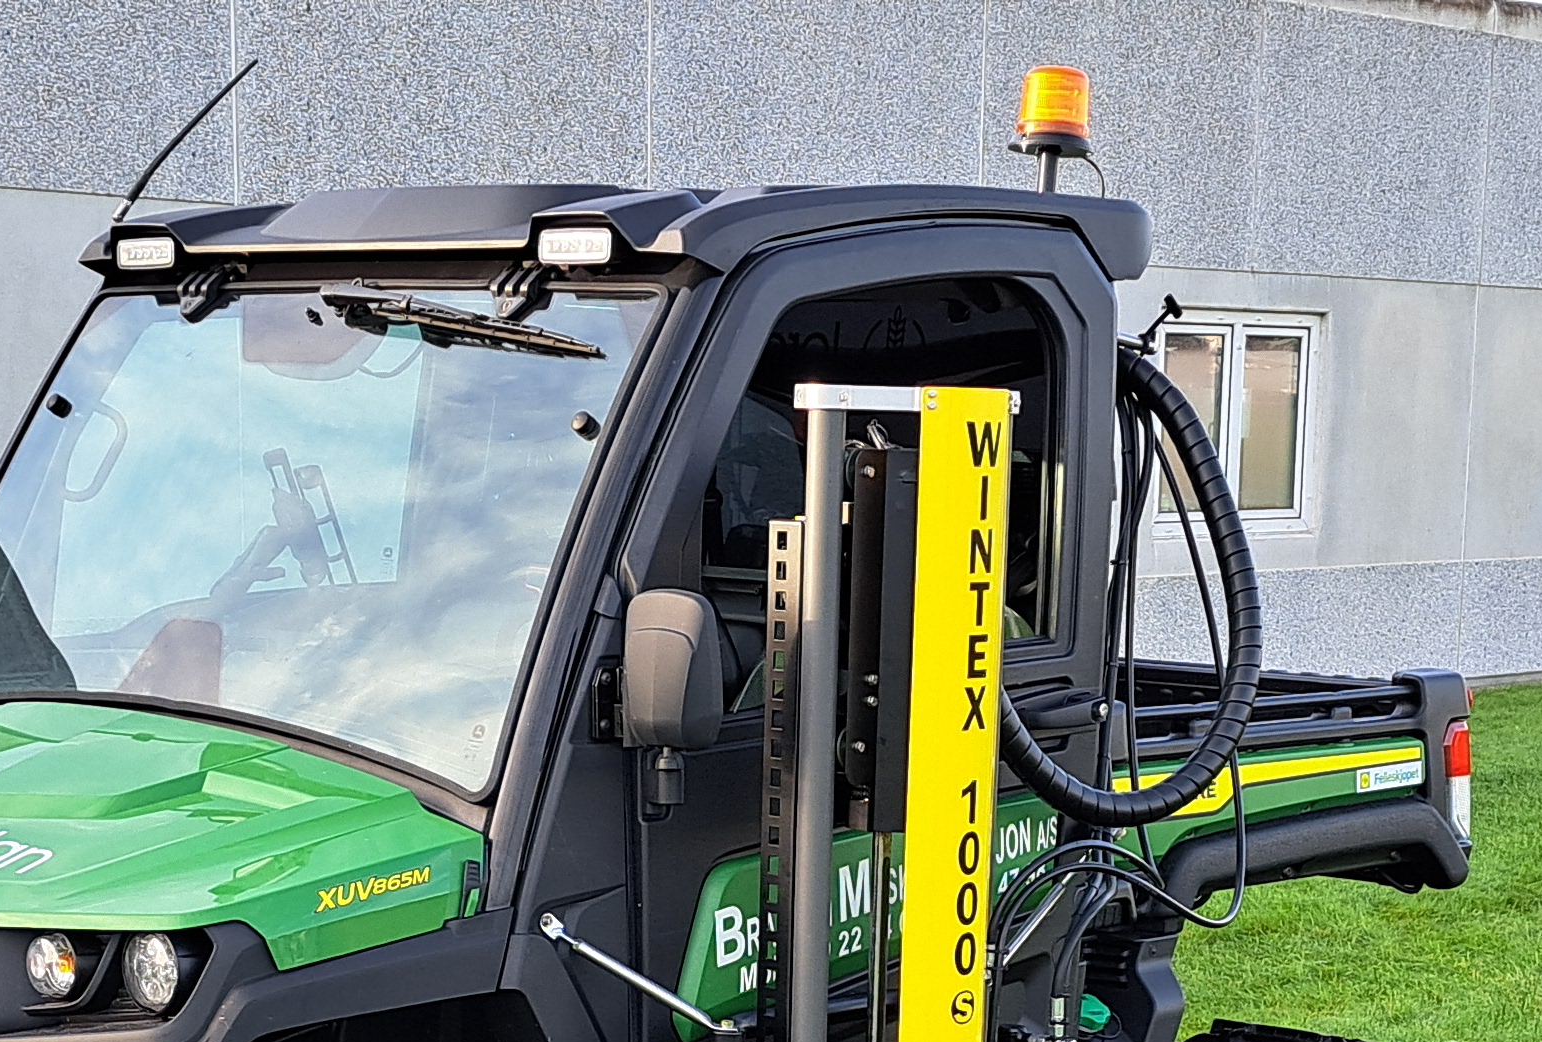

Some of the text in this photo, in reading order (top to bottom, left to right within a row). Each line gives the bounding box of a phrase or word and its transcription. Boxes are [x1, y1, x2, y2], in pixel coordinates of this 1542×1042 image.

[961, 421, 1002, 732] WINTEX
[315, 864, 431, 913] XUV865M
[954, 779, 980, 976] 1000
[1036, 816, 1058, 852] A/S
